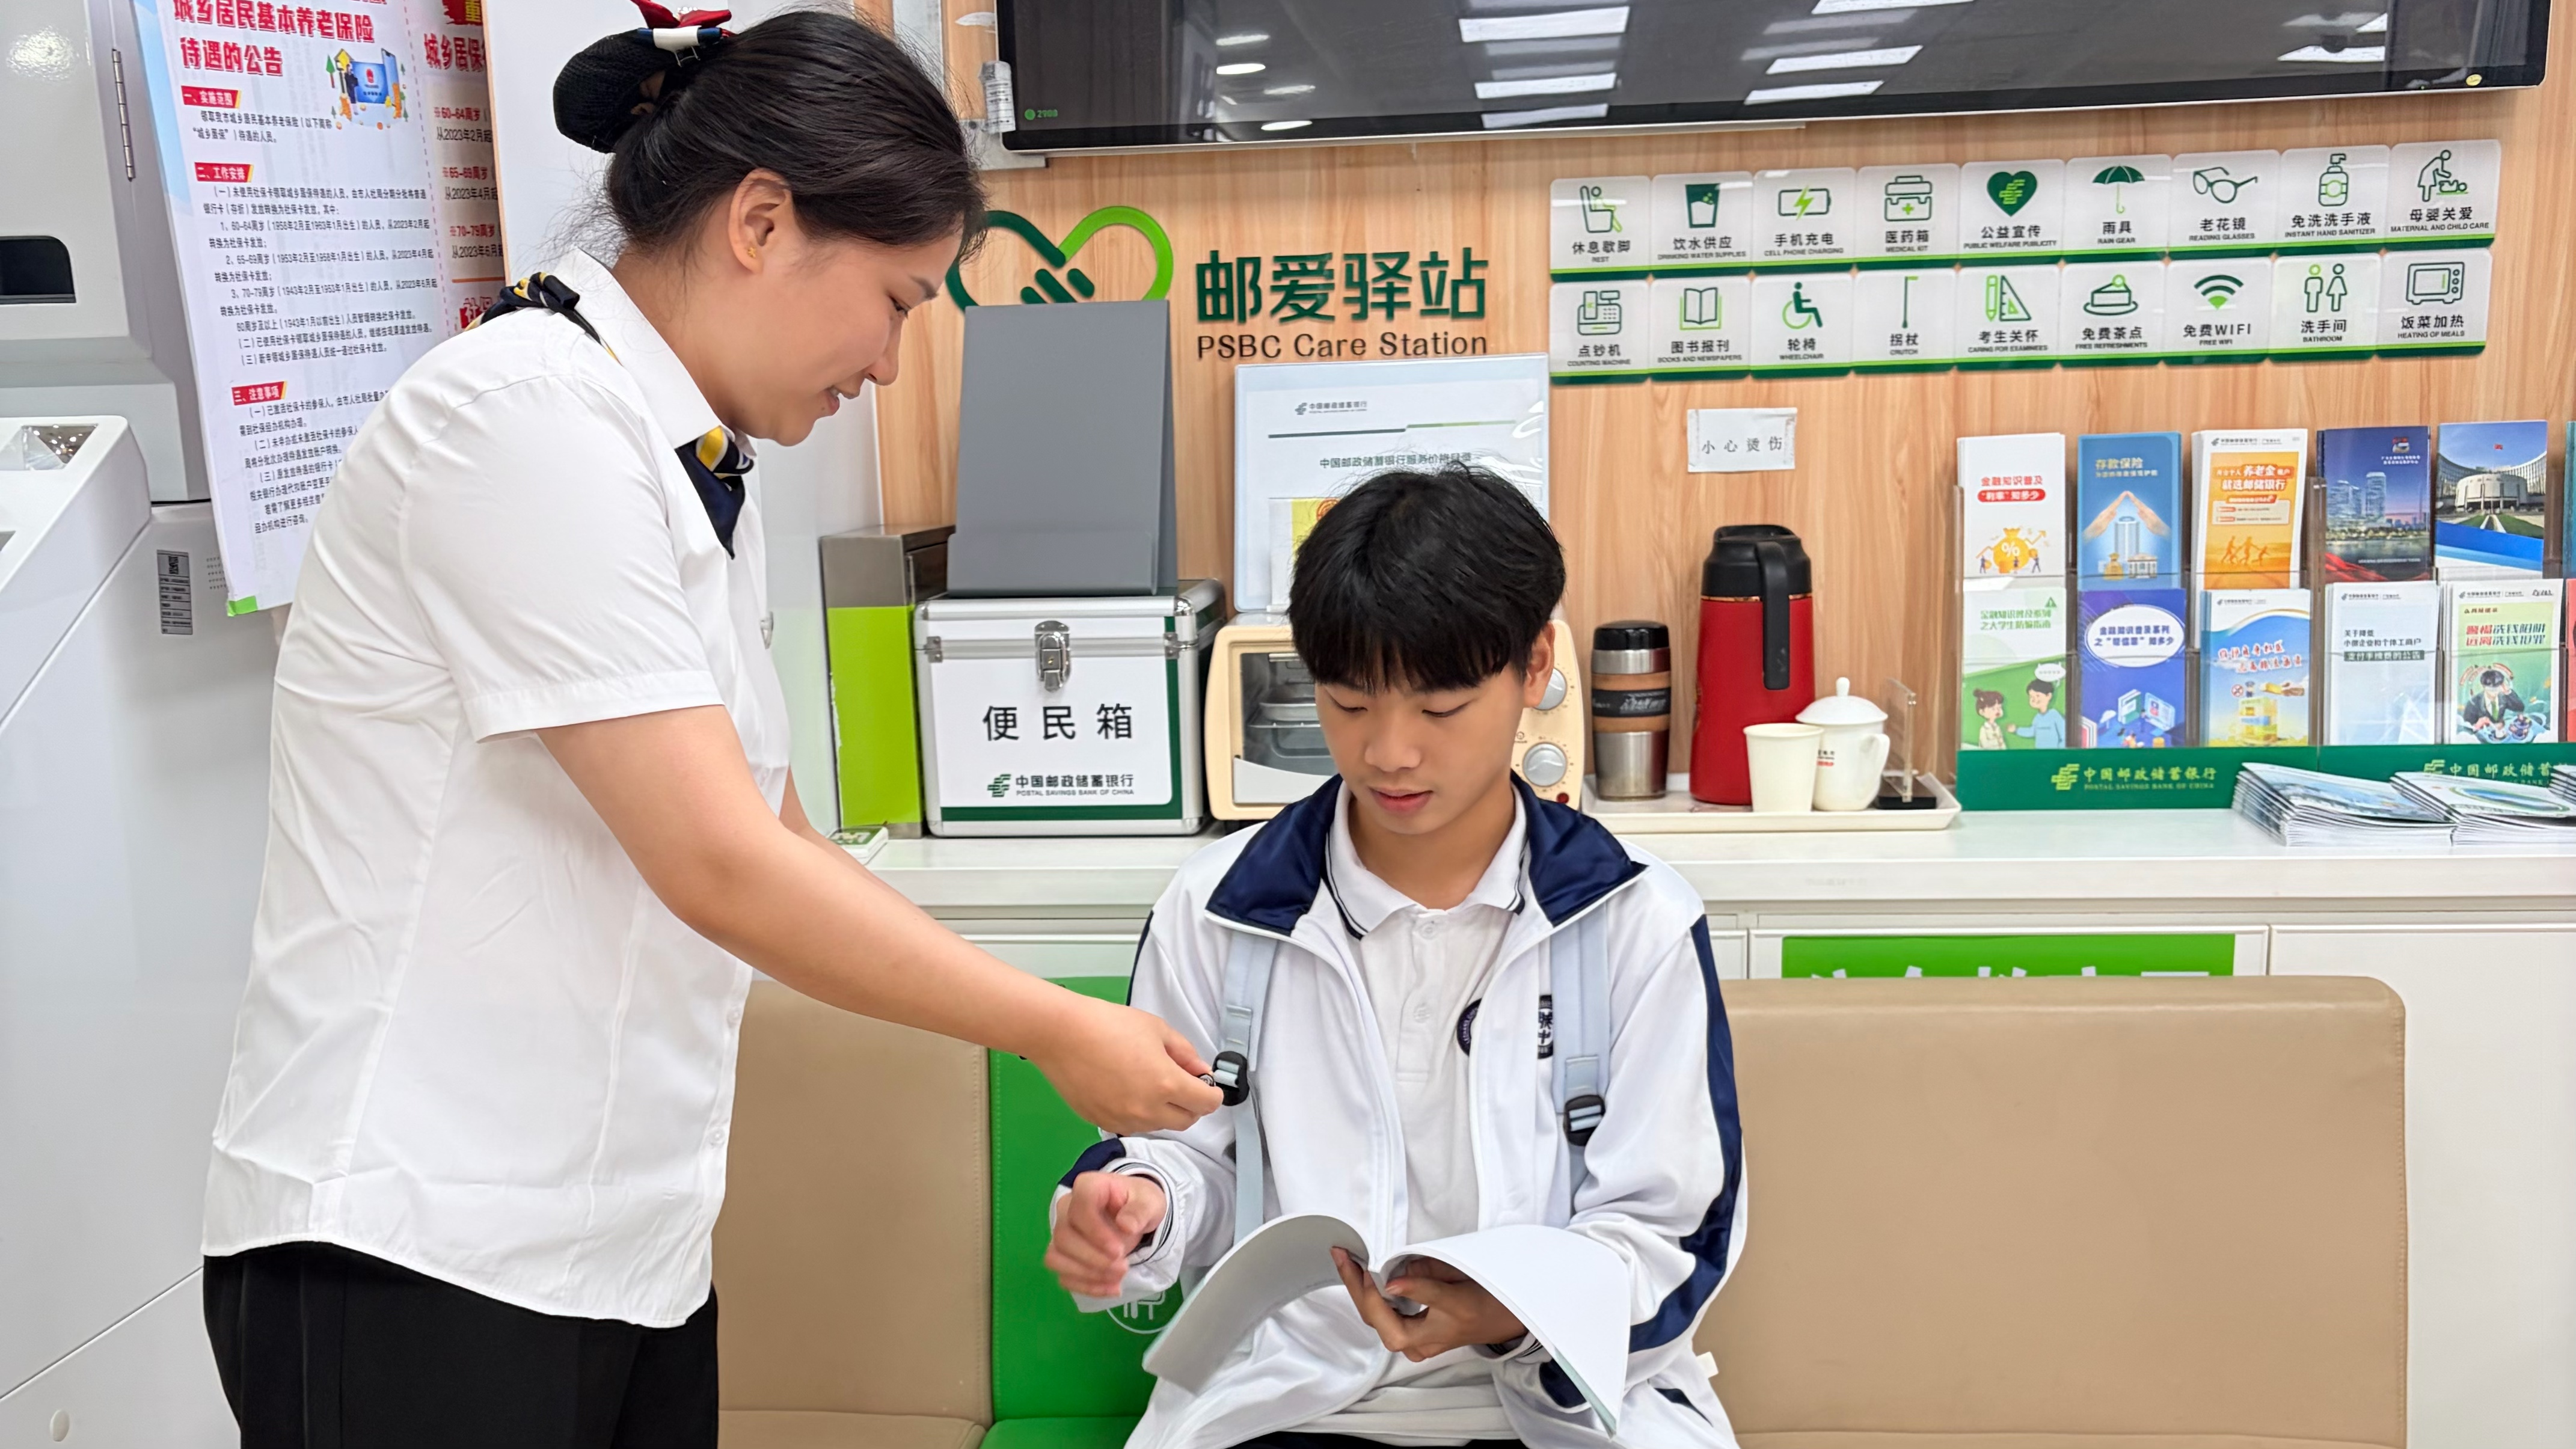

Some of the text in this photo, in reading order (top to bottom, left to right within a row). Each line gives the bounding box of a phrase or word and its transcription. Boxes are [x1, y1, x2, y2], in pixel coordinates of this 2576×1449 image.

[180, 37, 283, 76] 待遇的公告
[424, 33, 486, 72] 城乡居保
[2292, 212, 2372, 228] 免洗洗手液
[2409, 206, 2473, 222] 母婴关爱
[2103, 221, 2132, 234] 雨具
[2200, 217, 2246, 231] 老花镜
[1774, 233, 1834, 246] 手机充电
[1885, 230, 1930, 243] 医药箱
[1981, 225, 2041, 239] 公益宣传
[1572, 240, 1631, 254] 休息歇脚
[1673, 236, 1732, 250] 饮水供应
[1195, 247, 1488, 325] 邮爱驿站
[2301, 320, 2348, 334] 洗手间
[2401, 314, 2465, 329] 饭菜加热
[1979, 329, 2039, 344] 考生关怀
[2082, 326, 2142, 341] 免费茶点
[2183, 323, 2252, 338] 免费WIFI
[1198, 331, 1488, 360] PSBC Care Station
[1671, 339, 1729, 354] 图书报刊
[1788, 338, 1817, 351] 轮椅
[1890, 333, 1919, 346] 拐杖
[1578, 345, 1621, 357] 点钞机
[1702, 437, 1782, 455] 小心烫伤
[2096, 457, 2143, 470] 存款保险
[1981, 475, 2043, 486] 金融知识普及
[983, 703, 1133, 742] 便民箱
[2084, 767, 2217, 782] 中国邮政储蓄银行
[2450, 762, 2566, 779] 中国邮政储蓄
[1016, 774, 1135, 788] 中国邮政储蓄银行
